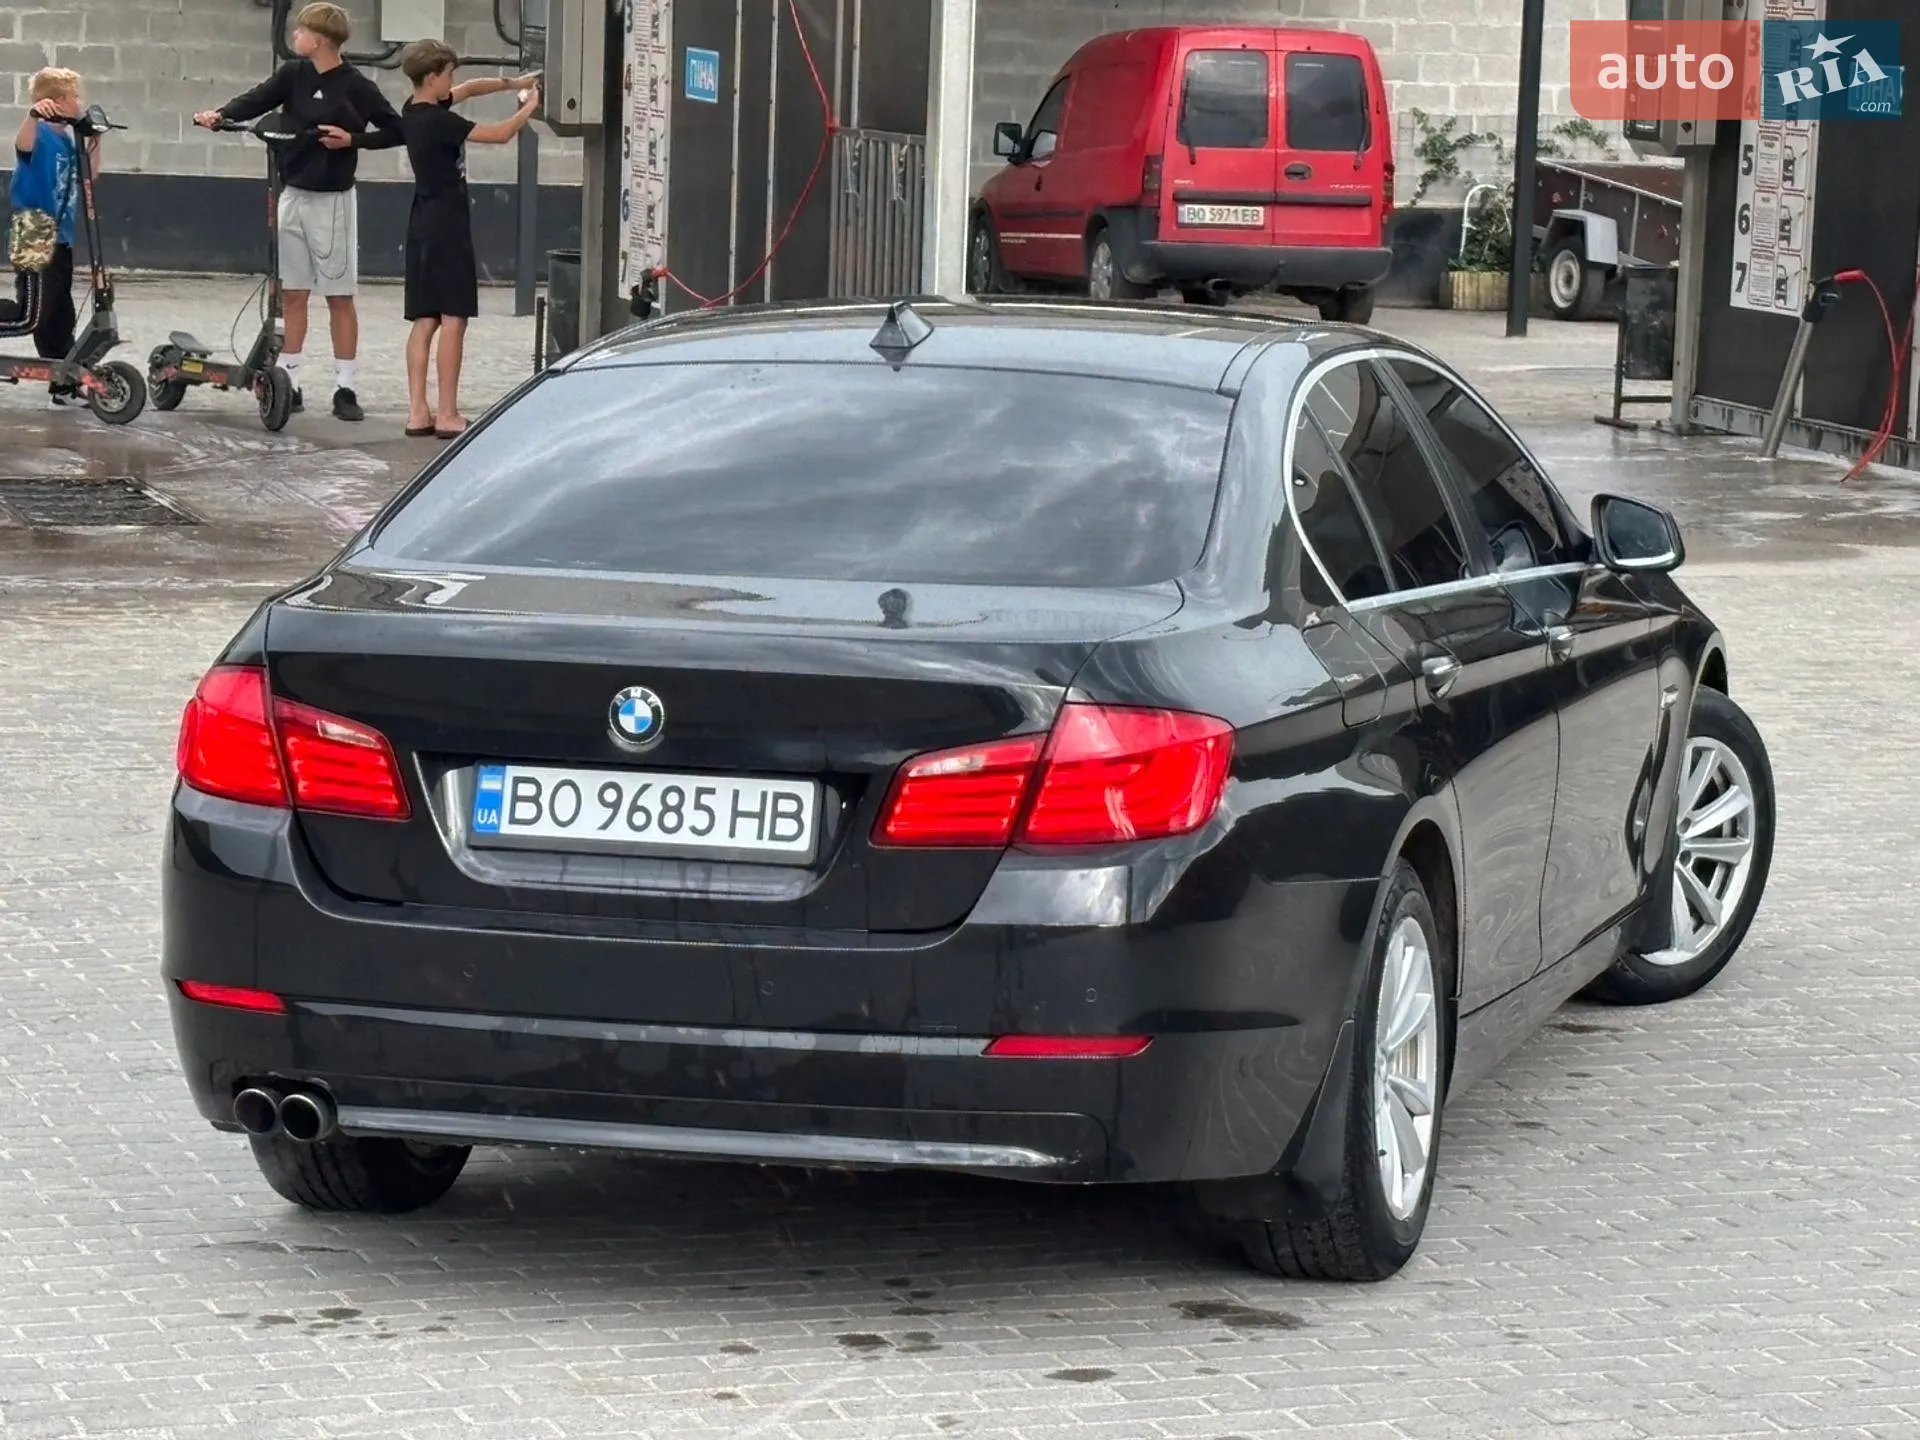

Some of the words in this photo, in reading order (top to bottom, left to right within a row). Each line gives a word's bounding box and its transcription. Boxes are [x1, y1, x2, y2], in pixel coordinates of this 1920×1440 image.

[1741, 144, 1754, 176] 5
[1738, 203, 1751, 235] 6
[1735, 262, 1748, 293] 7
[477, 809, 498, 826] UA
[508, 775, 583, 829] BO
[596, 780, 717, 838] 9685
[728, 788, 806, 844] HB
